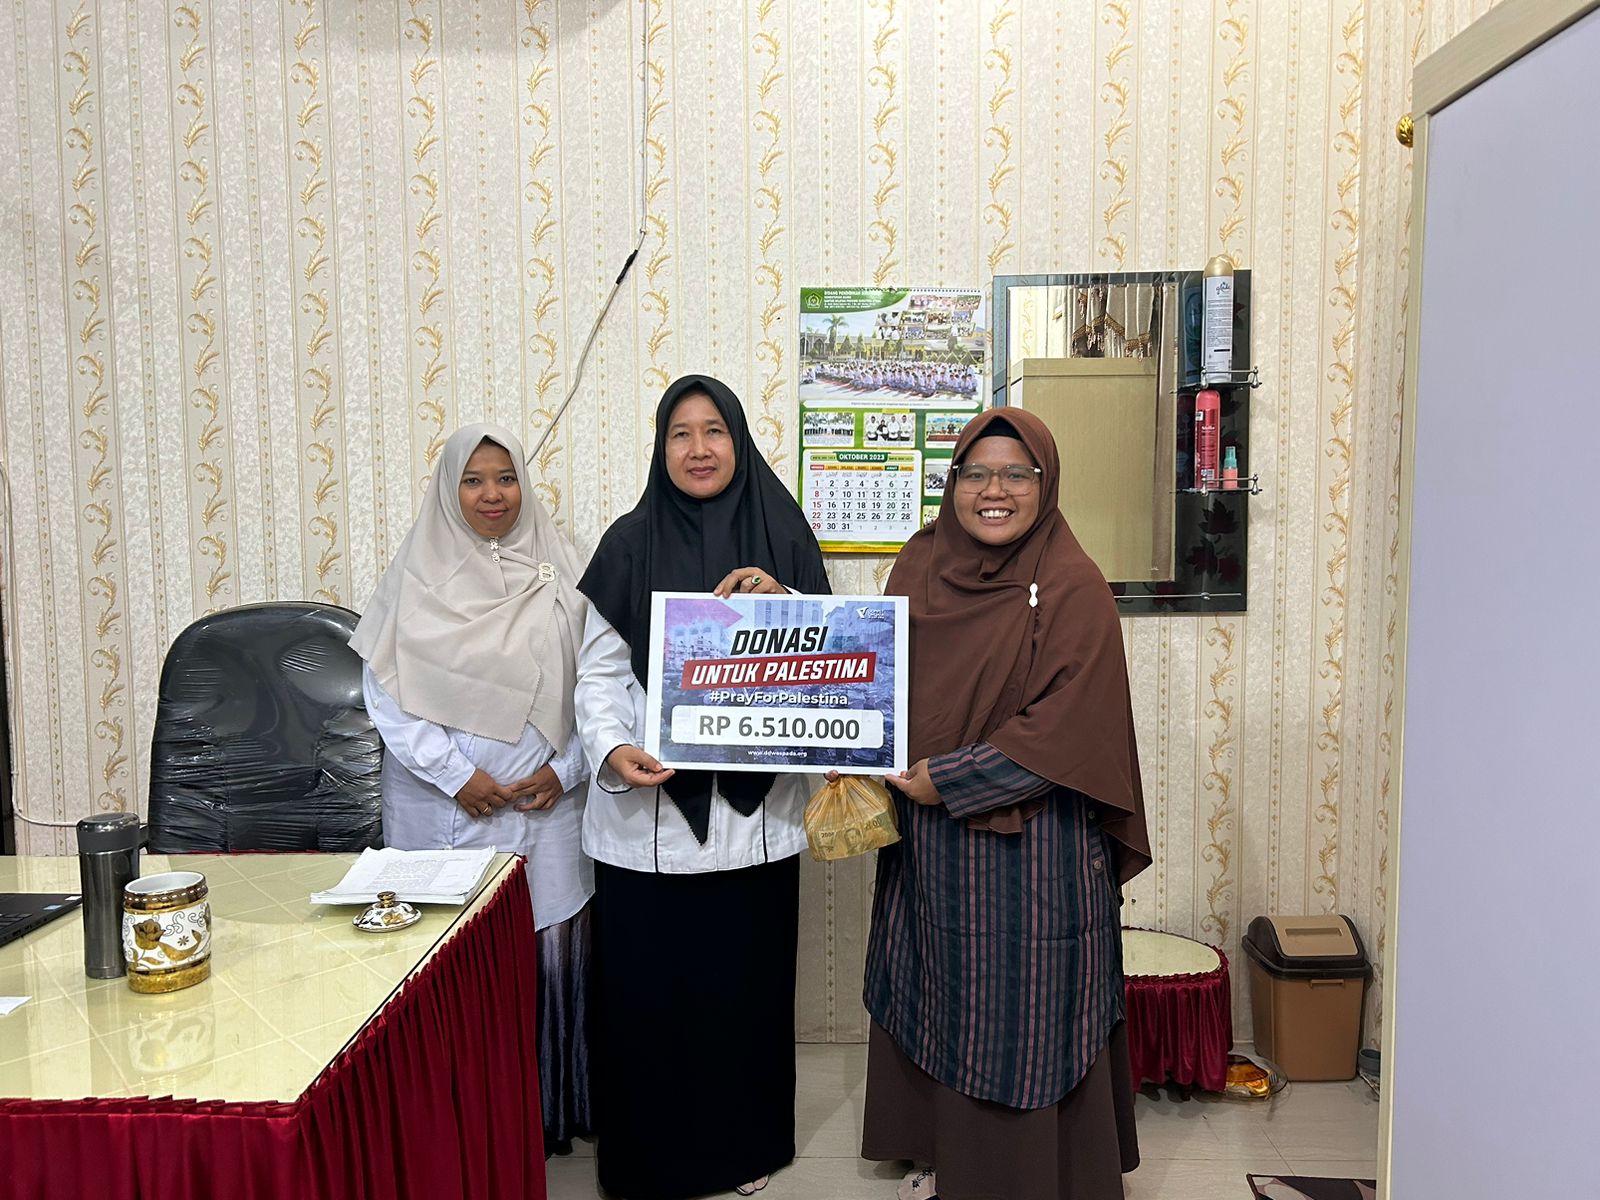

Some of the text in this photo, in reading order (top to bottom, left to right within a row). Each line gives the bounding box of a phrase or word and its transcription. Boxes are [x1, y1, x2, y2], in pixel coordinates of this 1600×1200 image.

[730, 626, 829, 656] DONASI
[690, 658, 869, 685] UNTUK PALESTINA
[709, 691, 848, 707] #PrayForPalestina
[699, 715, 860, 740] RP 6.510.000
